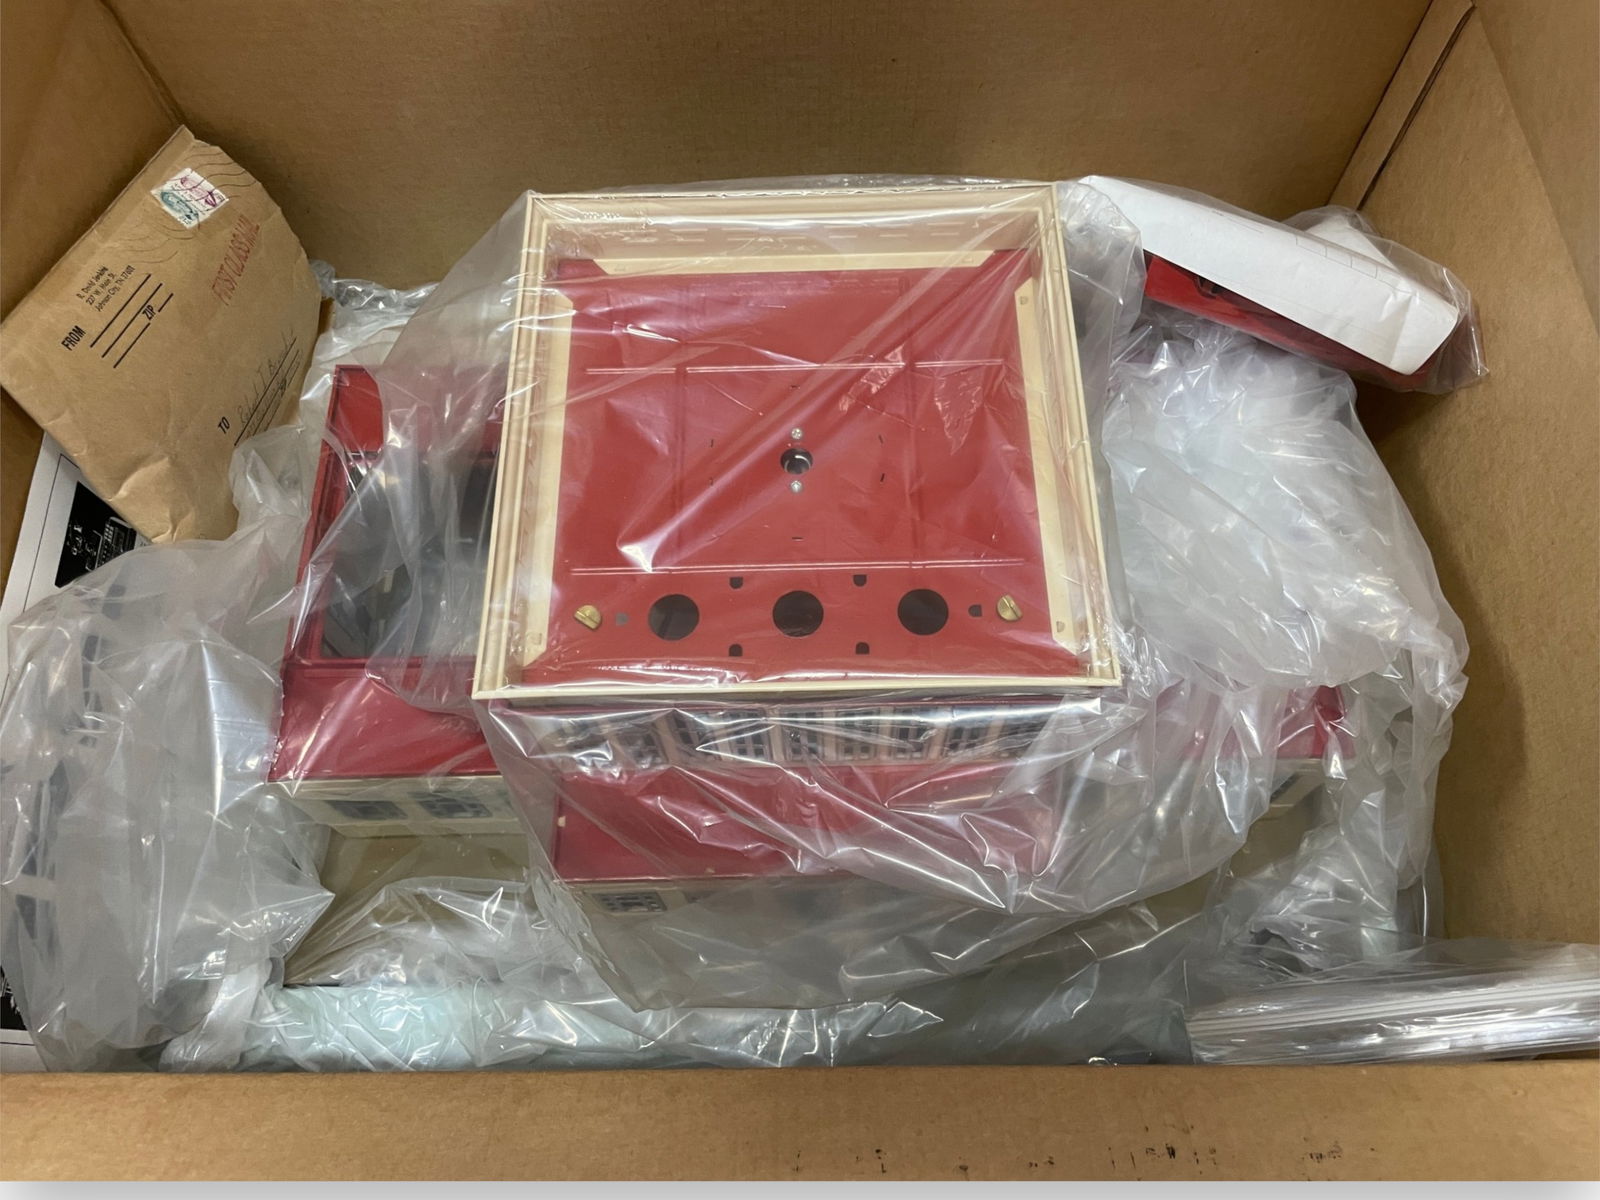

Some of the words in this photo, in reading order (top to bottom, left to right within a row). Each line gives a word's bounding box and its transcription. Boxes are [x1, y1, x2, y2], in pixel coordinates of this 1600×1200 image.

[224, 233, 251, 277] CLASS
[95, 294, 112, 312] Johnson
[142, 304, 157, 321] ZIP
[61, 325, 86, 351] FROM
[218, 416, 230, 434] TO
